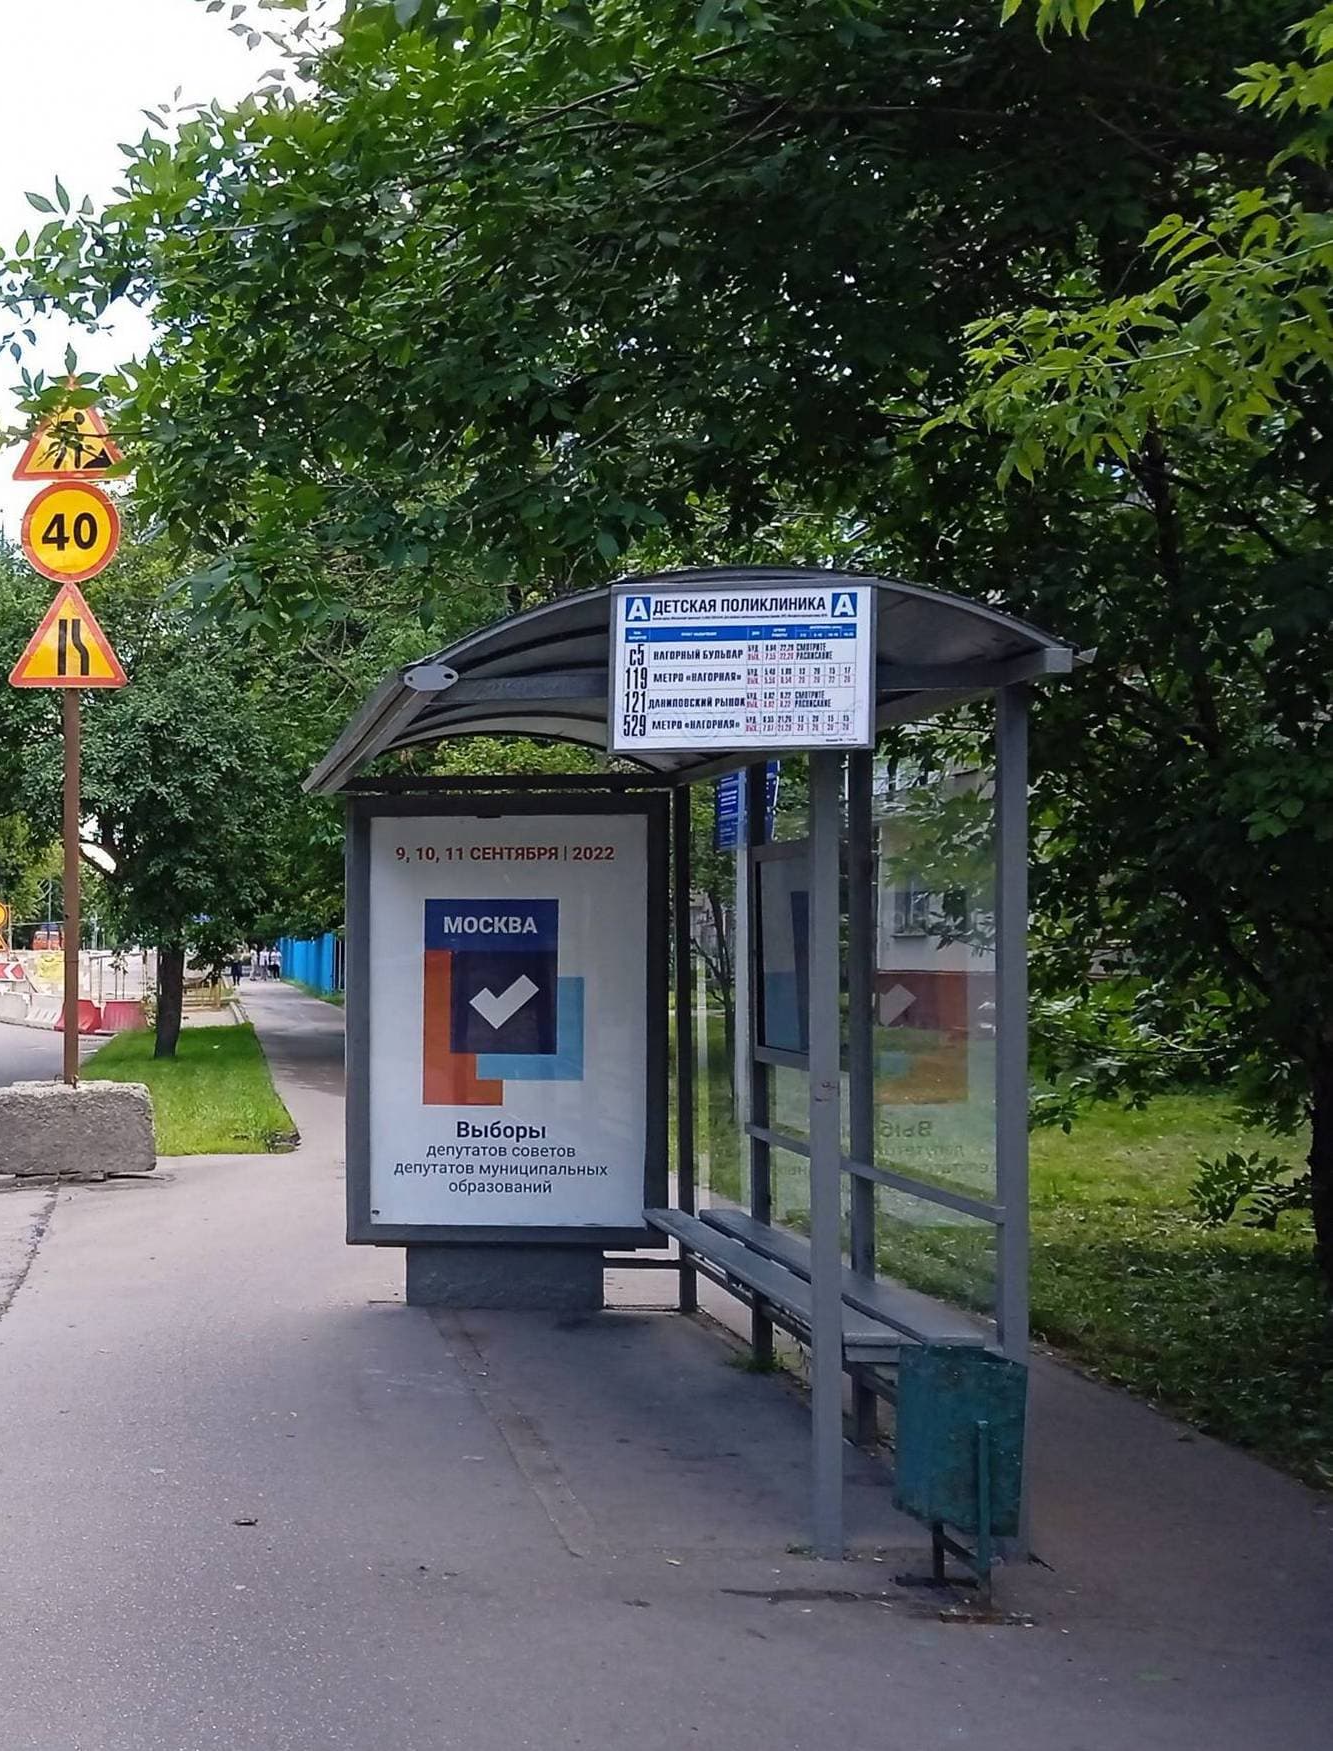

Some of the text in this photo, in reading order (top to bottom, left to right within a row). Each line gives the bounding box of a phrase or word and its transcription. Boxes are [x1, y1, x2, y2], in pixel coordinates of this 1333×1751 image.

[41, 512, 98, 551] 40
[653, 599, 717, 616] ДЕТСКАЯ
[721, 596, 826, 613] ПОЛИКЛИНИКА
[653, 649, 744, 660] НАГОРНЫЙ БУЛЬВАР
[625, 667, 648, 690] 119
[653, 672, 742, 683] МЕТРО «НАГОРНАЯ»
[625, 690, 646, 713] 121
[648, 697, 746, 709] ДАНИЛОВСКИЙ РЫНОК
[623, 714, 647, 737] 529
[652, 719, 740, 730] МЕТРО «НАГОРНАЯ»
[395, 847, 410, 863] 9,
[417, 847, 440, 863] 10,
[445, 847, 464, 861] 11
[469, 847, 559, 861] СЕНТЯБРЯ
[572, 847, 615, 861] 2022
[443, 916, 538, 934] МОСКВА
[456, 1121, 547, 1143] Выборы
[426, 1144, 576, 1159] депутатов советов
[393, 1162, 608, 1178] депутатов муниципальных
[448, 1179, 553, 1196] образований
